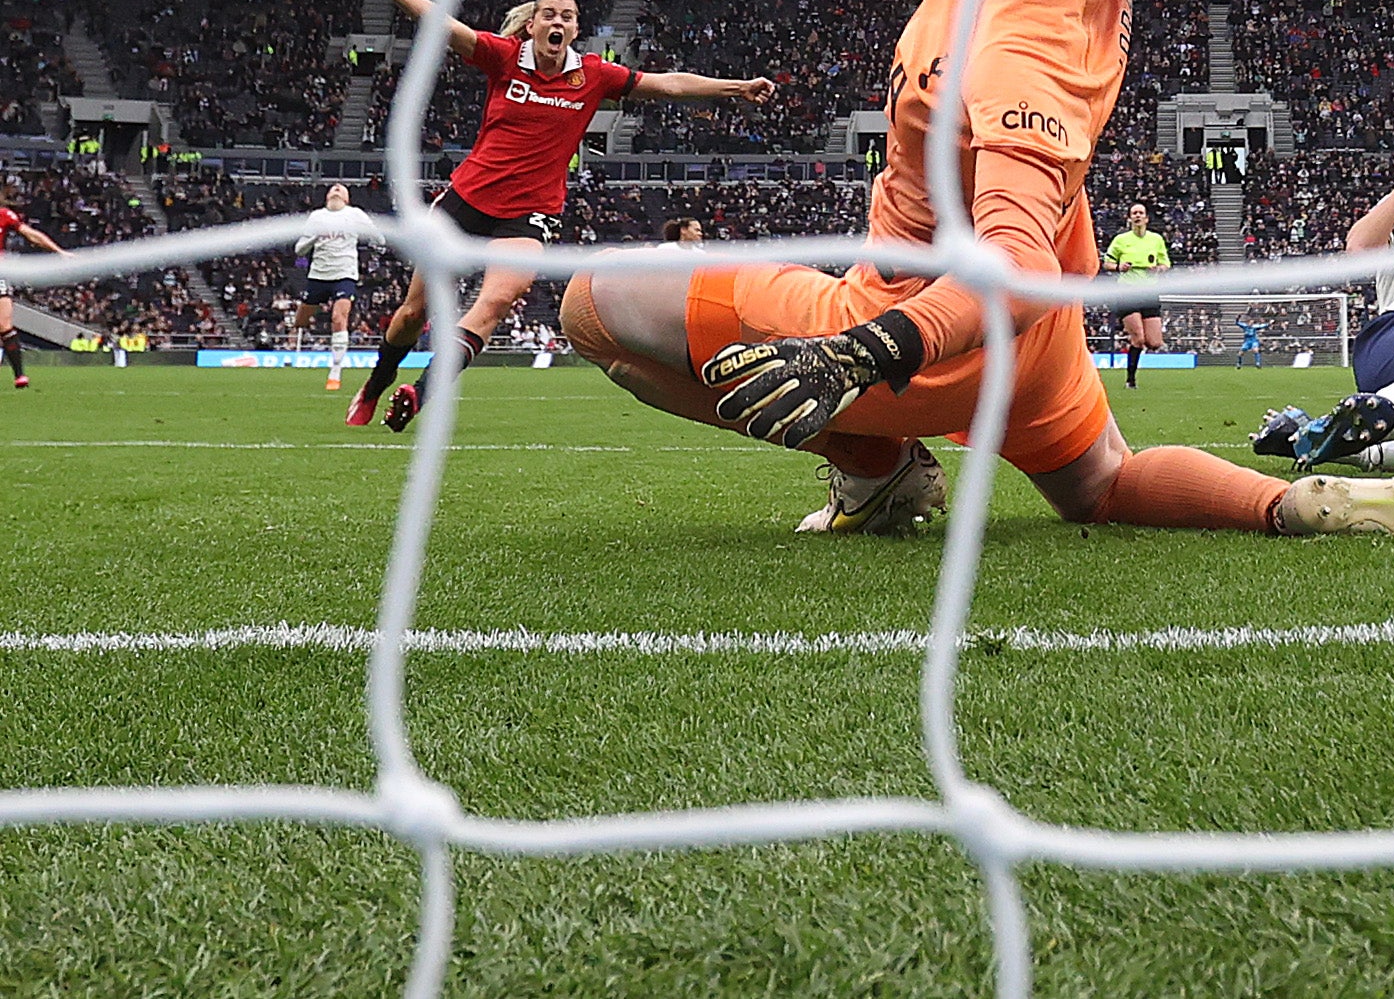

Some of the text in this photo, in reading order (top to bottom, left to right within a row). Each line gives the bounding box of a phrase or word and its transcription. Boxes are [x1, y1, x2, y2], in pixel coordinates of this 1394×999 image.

[528, 90, 585, 111] TeamViewer
[1001, 101, 1069, 147] cinch
[710, 343, 778, 382] reusch
